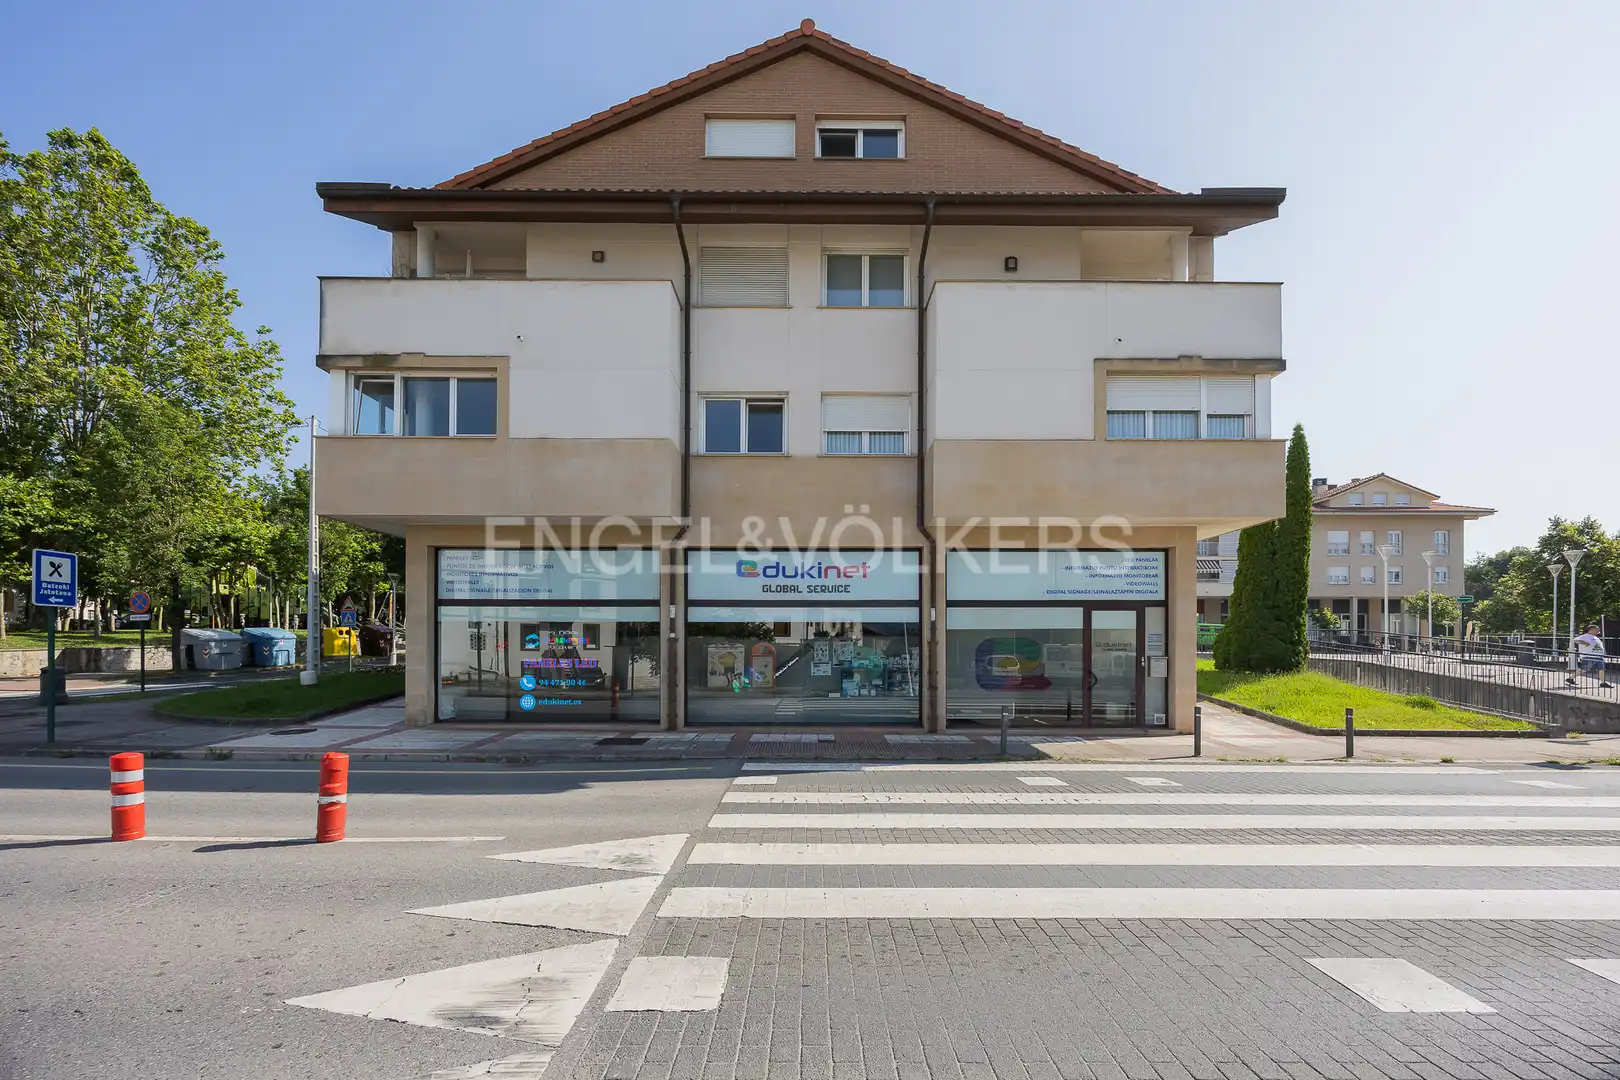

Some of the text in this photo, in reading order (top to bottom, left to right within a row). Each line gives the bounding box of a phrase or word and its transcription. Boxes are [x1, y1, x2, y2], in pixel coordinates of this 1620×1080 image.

[762, 584, 851, 594] GLOBAL SERVICE
[524, 658, 597, 668] PANELES LED
